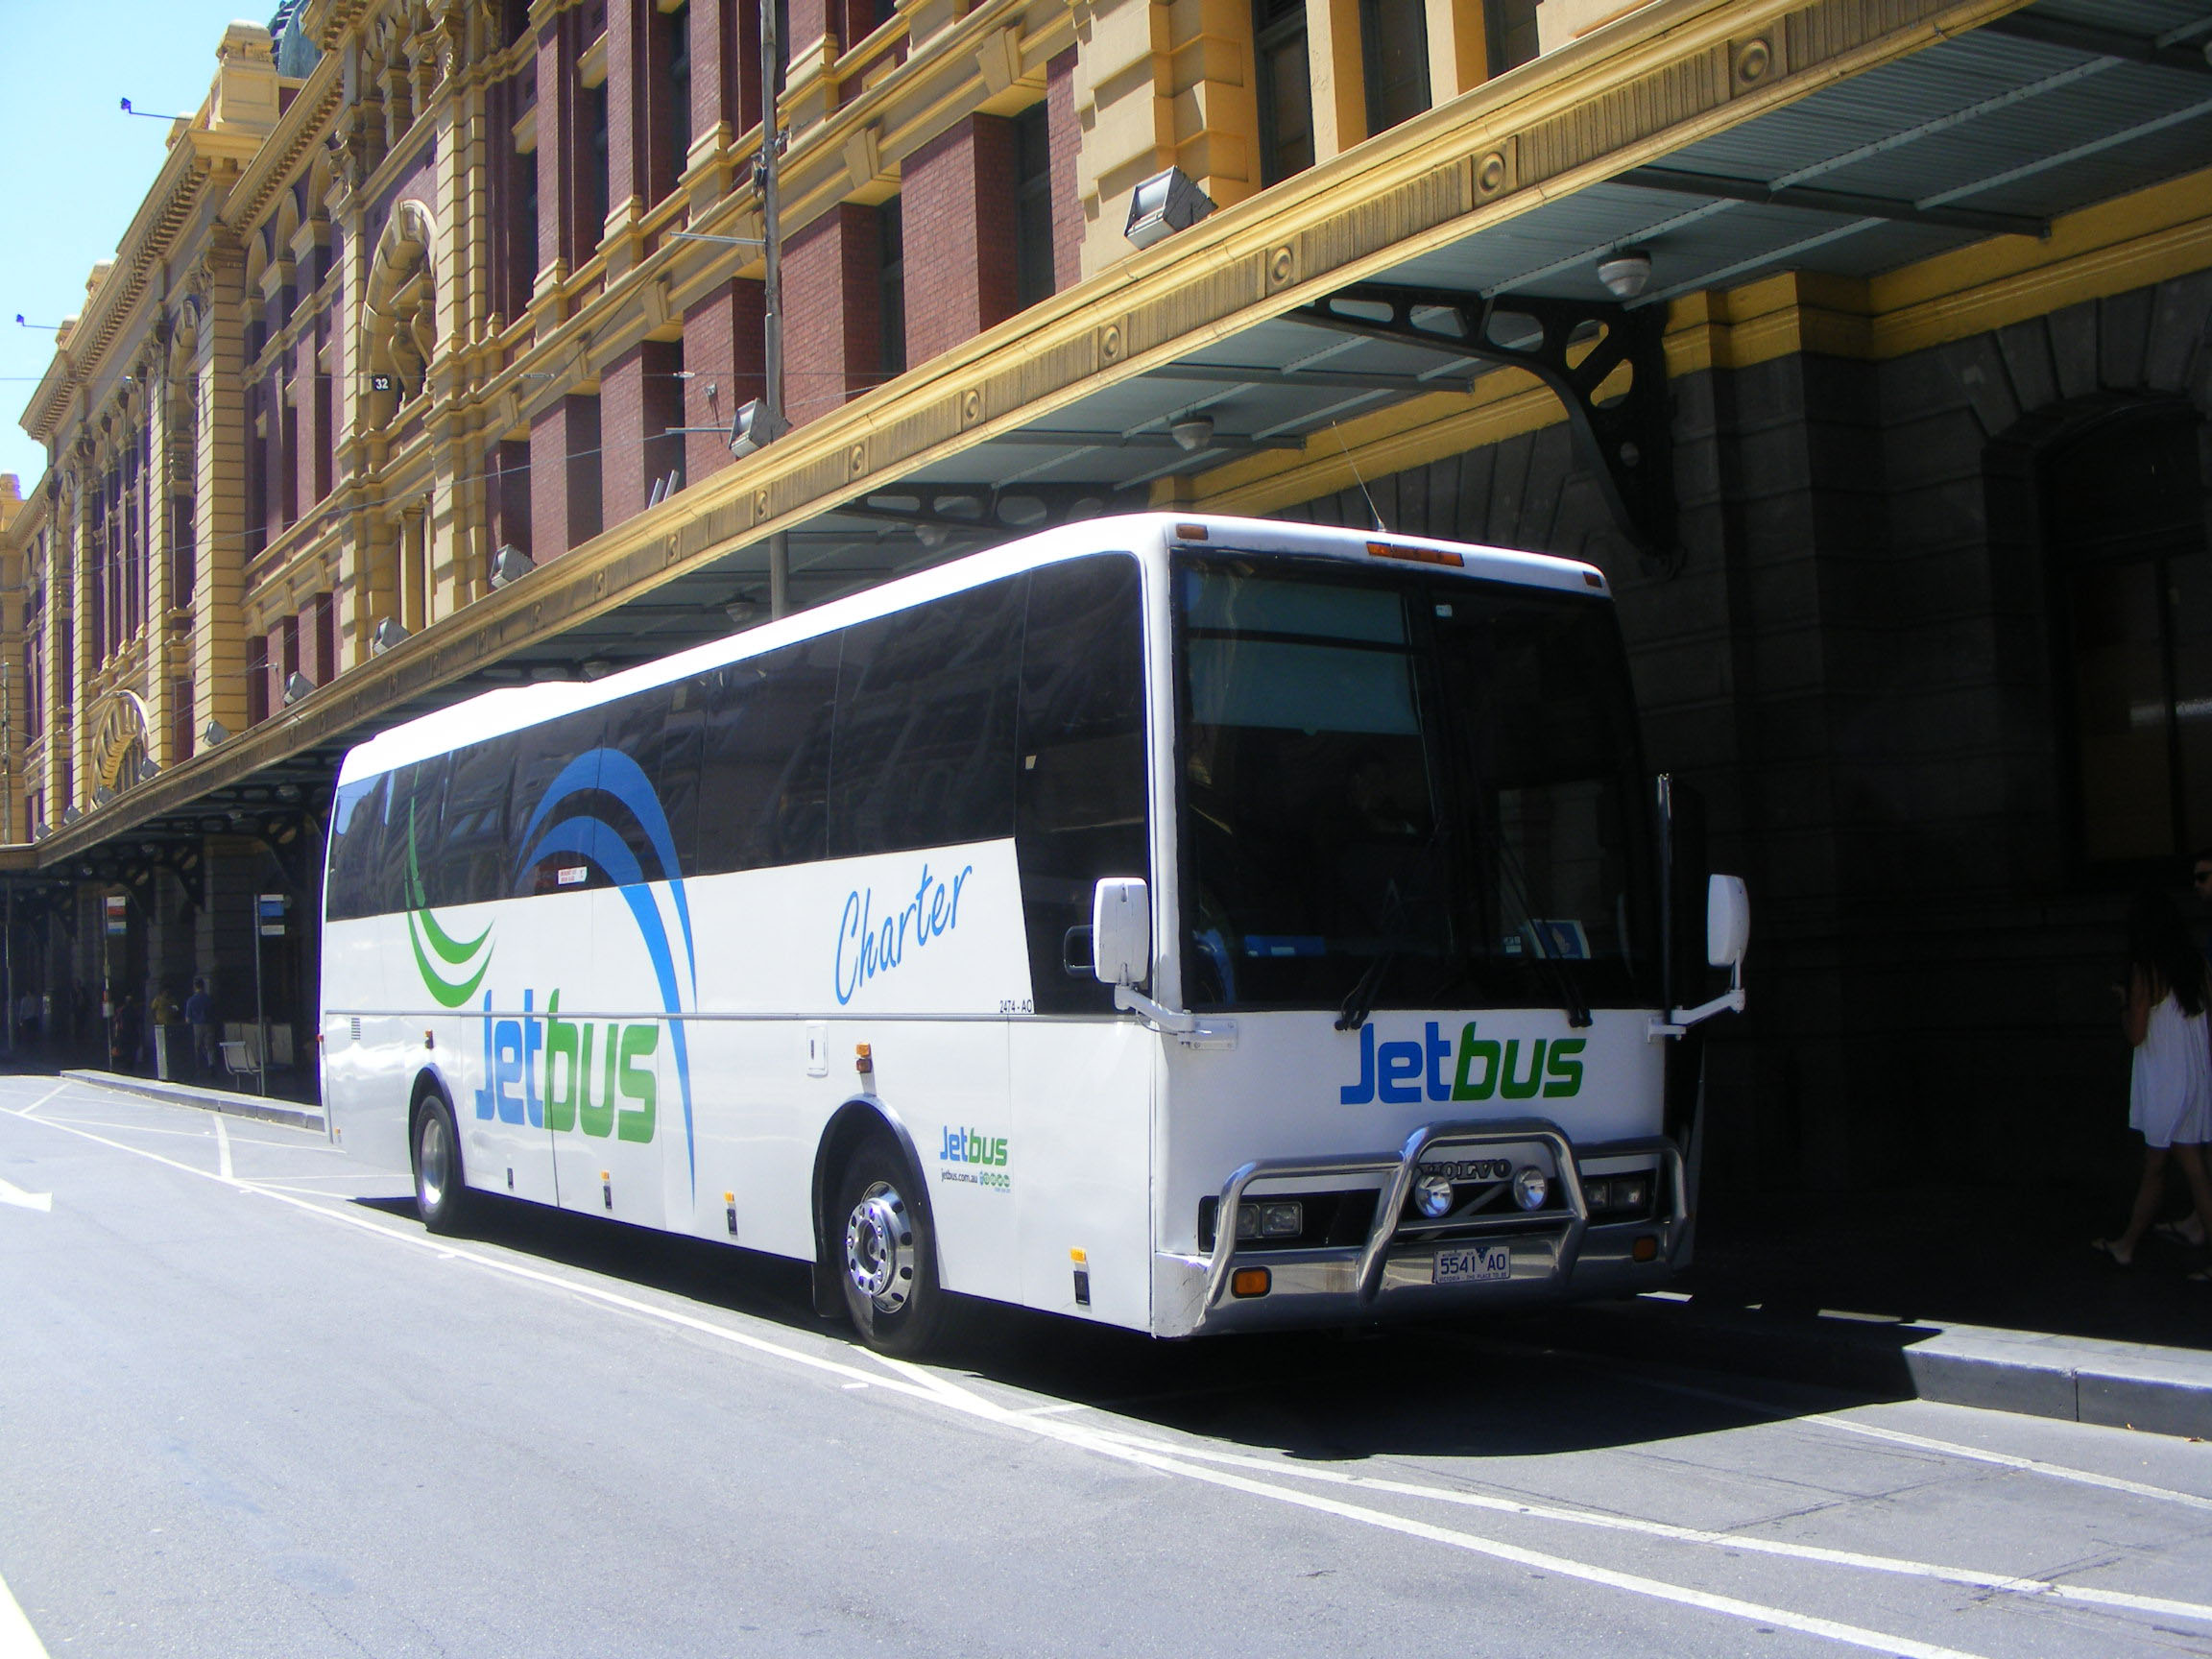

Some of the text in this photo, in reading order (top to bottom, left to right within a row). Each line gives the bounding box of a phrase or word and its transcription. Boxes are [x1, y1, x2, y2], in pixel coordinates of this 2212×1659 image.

[374, 377, 389, 390] 32
[835, 863, 973, 1005] Charter
[1340, 1022, 1587, 1105] Jetbus
[1419, 1159, 1512, 1180] VOLVO
[1441, 1256, 1476, 1275] 5541
